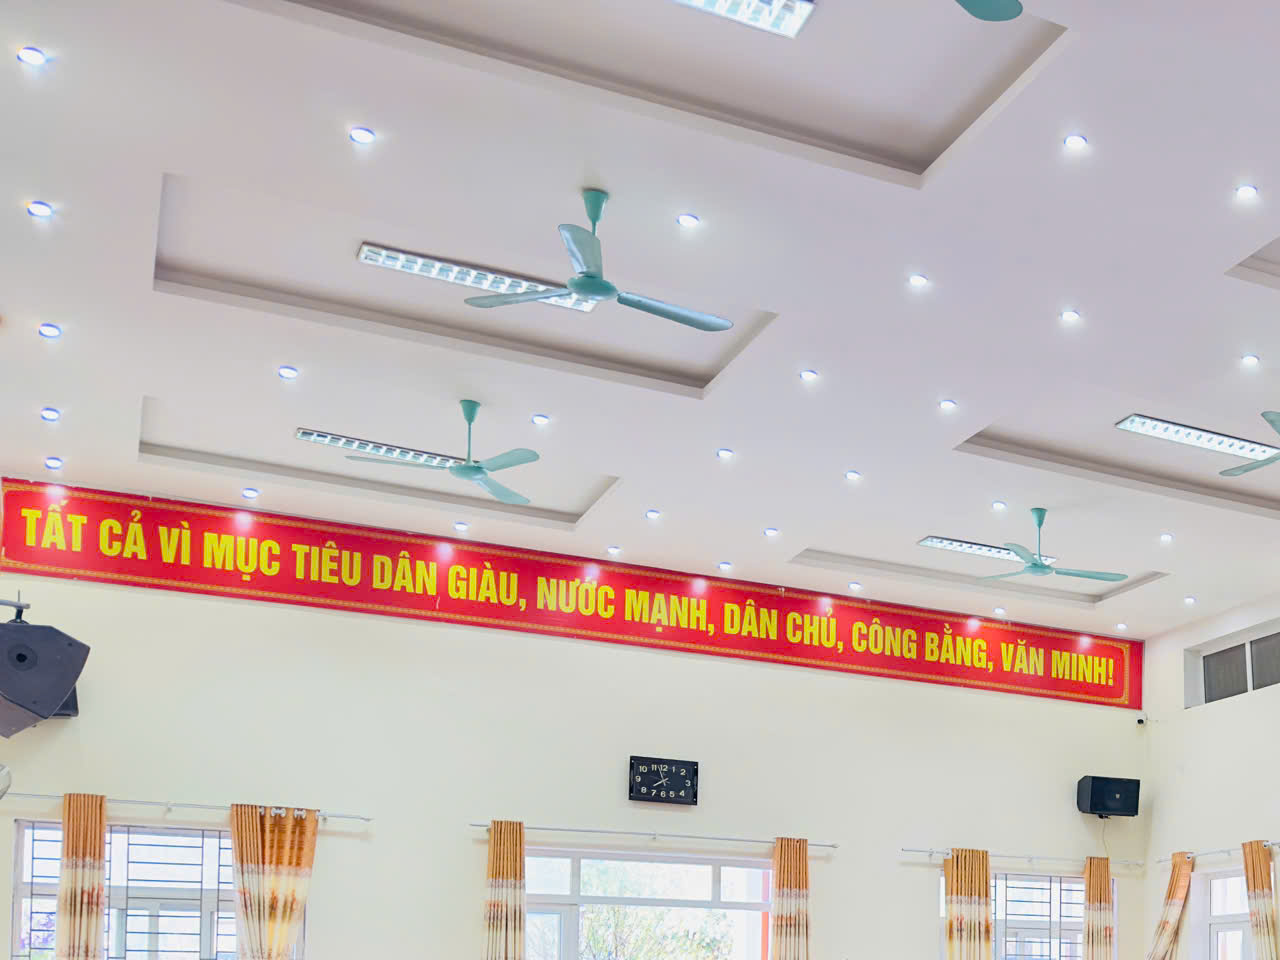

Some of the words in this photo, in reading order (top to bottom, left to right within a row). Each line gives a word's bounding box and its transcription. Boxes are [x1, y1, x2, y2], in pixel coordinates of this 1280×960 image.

[22, 499, 87, 551] TẤT
[100, 511, 146, 559] CẢ
[160, 522, 190, 564] VÌ
[204, 533, 280, 580] MỤC
[292, 540, 360, 585] TIÊU
[374, 552, 437, 595] DÂN
[448, 563, 526, 610] GIÀU,
[538, 578, 614, 618] NƯỚC
[626, 590, 714, 635] MẠNH,
[724, 600, 777, 639] DÂN
[788, 608, 843, 652] CHỦ,
[853, 618, 916, 658] CÔNG
[926, 622, 992, 672] BẰNG,
[1002, 641, 1043, 675] VĂN
[1052, 651, 1113, 685] MINH!
[639, 765, 648, 773] 10
[660, 764, 668, 772] 12
[680, 768, 687, 776] 2
[641, 786, 647, 794] 8
[651, 789, 657, 797] 7
